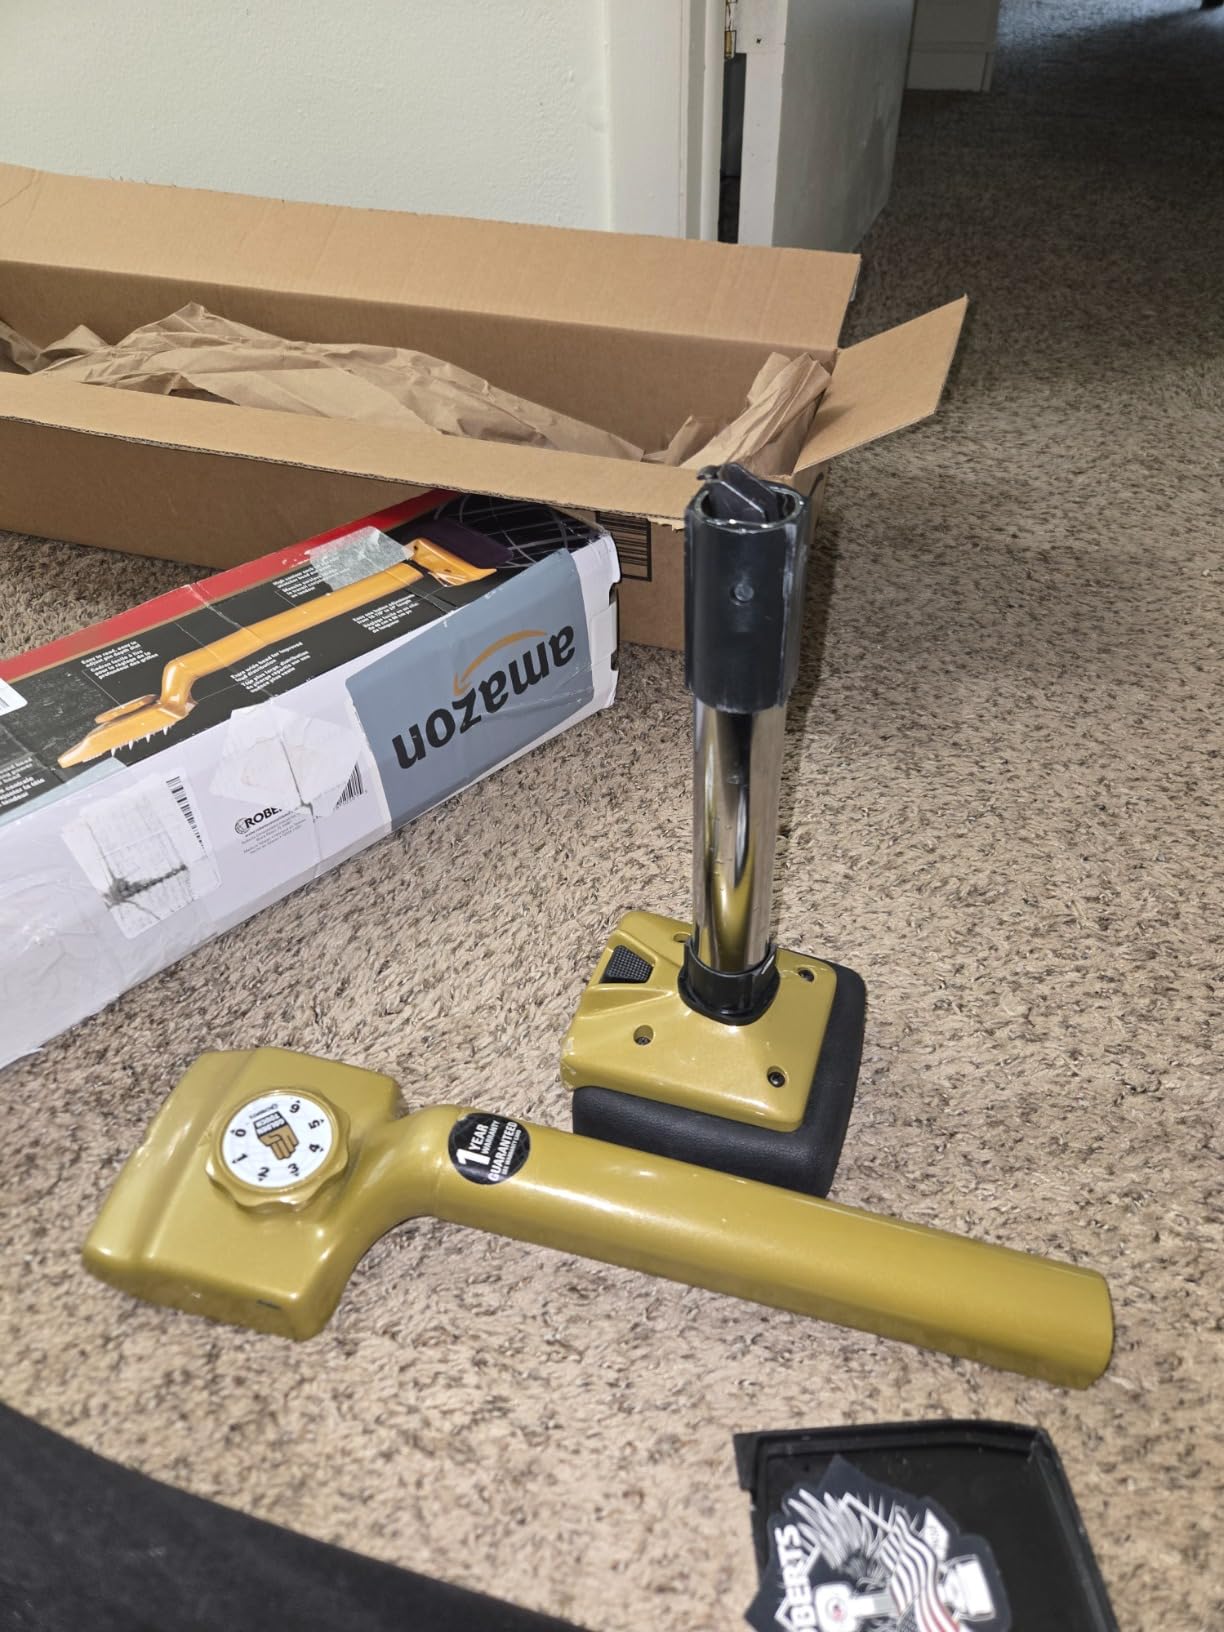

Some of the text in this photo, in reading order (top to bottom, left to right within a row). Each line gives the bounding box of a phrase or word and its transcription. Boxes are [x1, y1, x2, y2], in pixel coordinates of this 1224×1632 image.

[392, 625, 576, 769] amazon
[244, 807, 282, 828] ROBE
[308, 1120, 320, 1129] 5
[456, 1123, 491, 1165] 1 YEAR
[480, 1120, 501, 1154] WARRANTY
[308, 1144, 319, 1152] 4
[487, 1121, 518, 1182] GUARANTEED
[236, 1153, 247, 1161] 1
[257, 1166, 269, 1177] 2
[287, 1163, 299, 1173] 3
